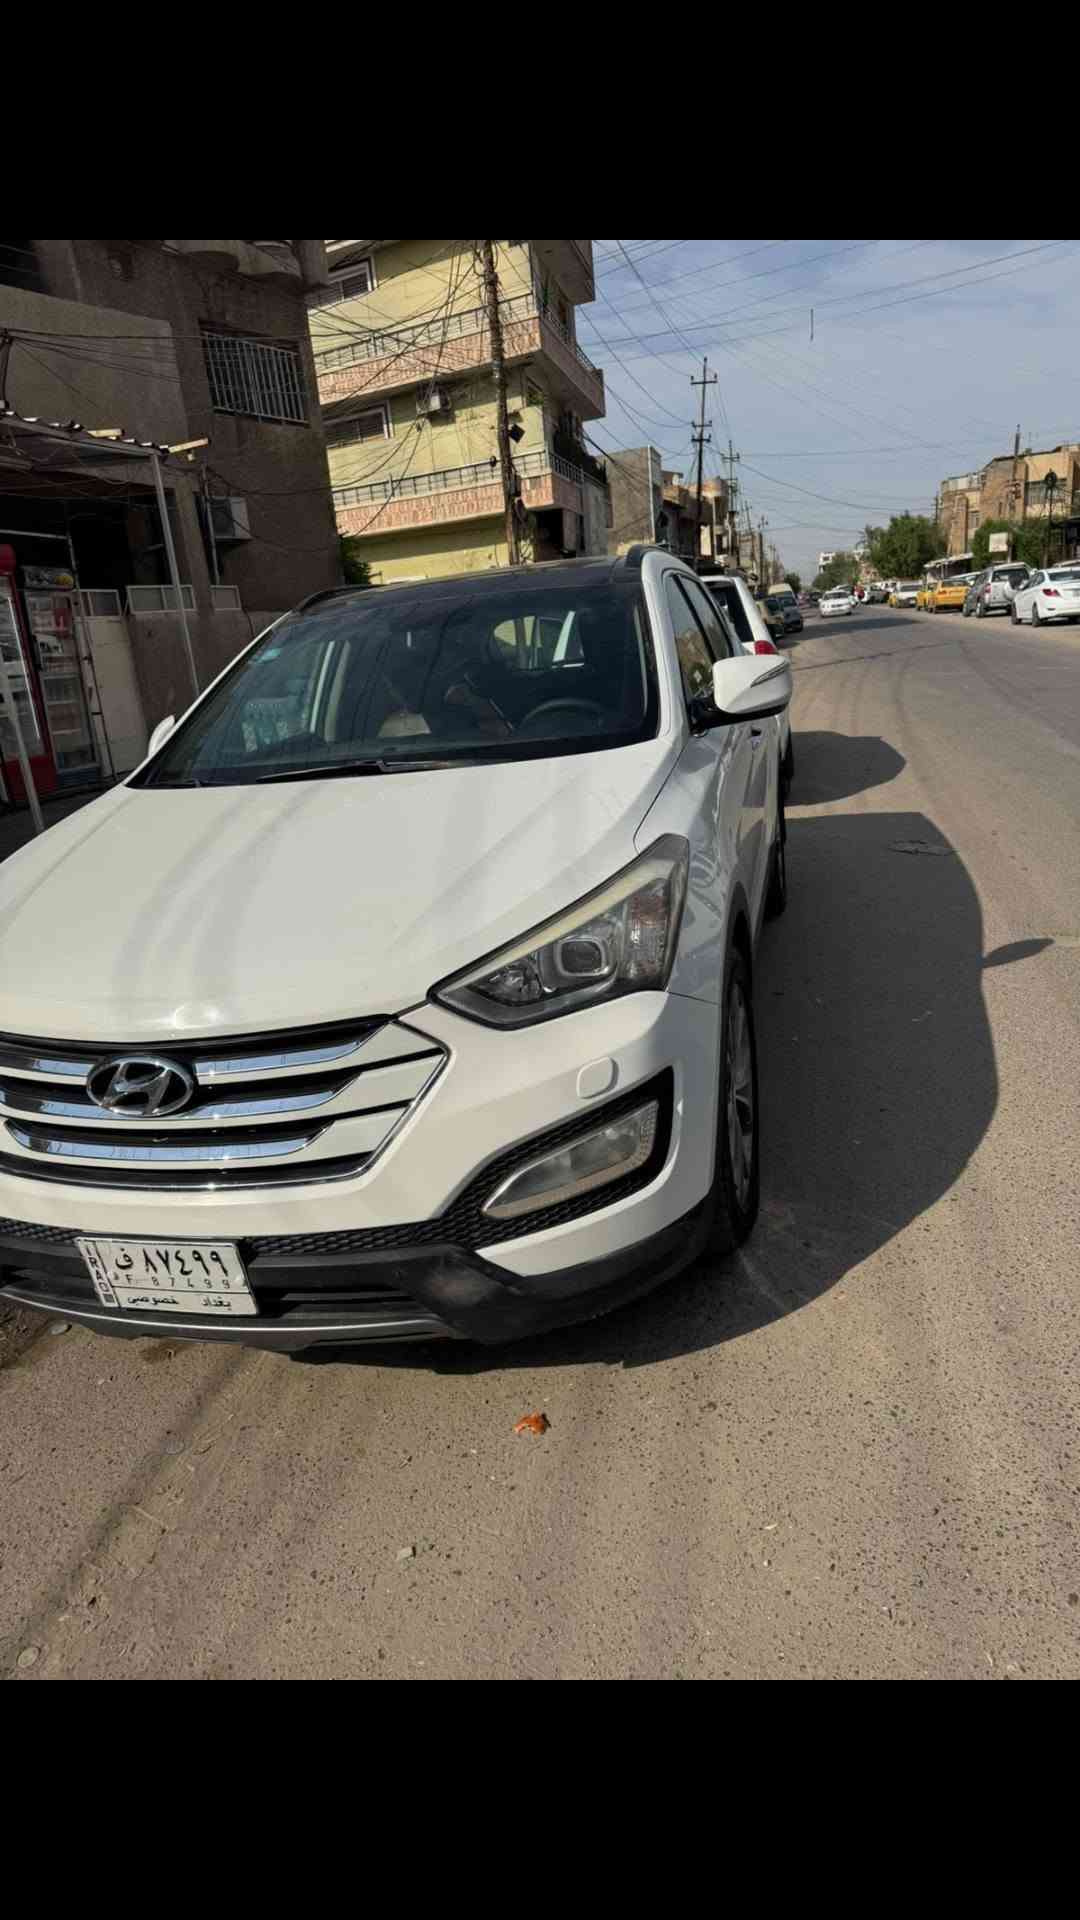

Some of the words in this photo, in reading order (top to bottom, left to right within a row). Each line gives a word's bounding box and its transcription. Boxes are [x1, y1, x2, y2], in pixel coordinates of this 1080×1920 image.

[84, 1243, 110, 1293] IRAQ
[114, 1248, 134, 1270] ف
[142, 1247, 229, 1277] ٨٧٤٩٩
[126, 1273, 132, 1284] F
[151, 1276, 231, 1289] 87499
[201, 1297, 233, 1311] بغداد
